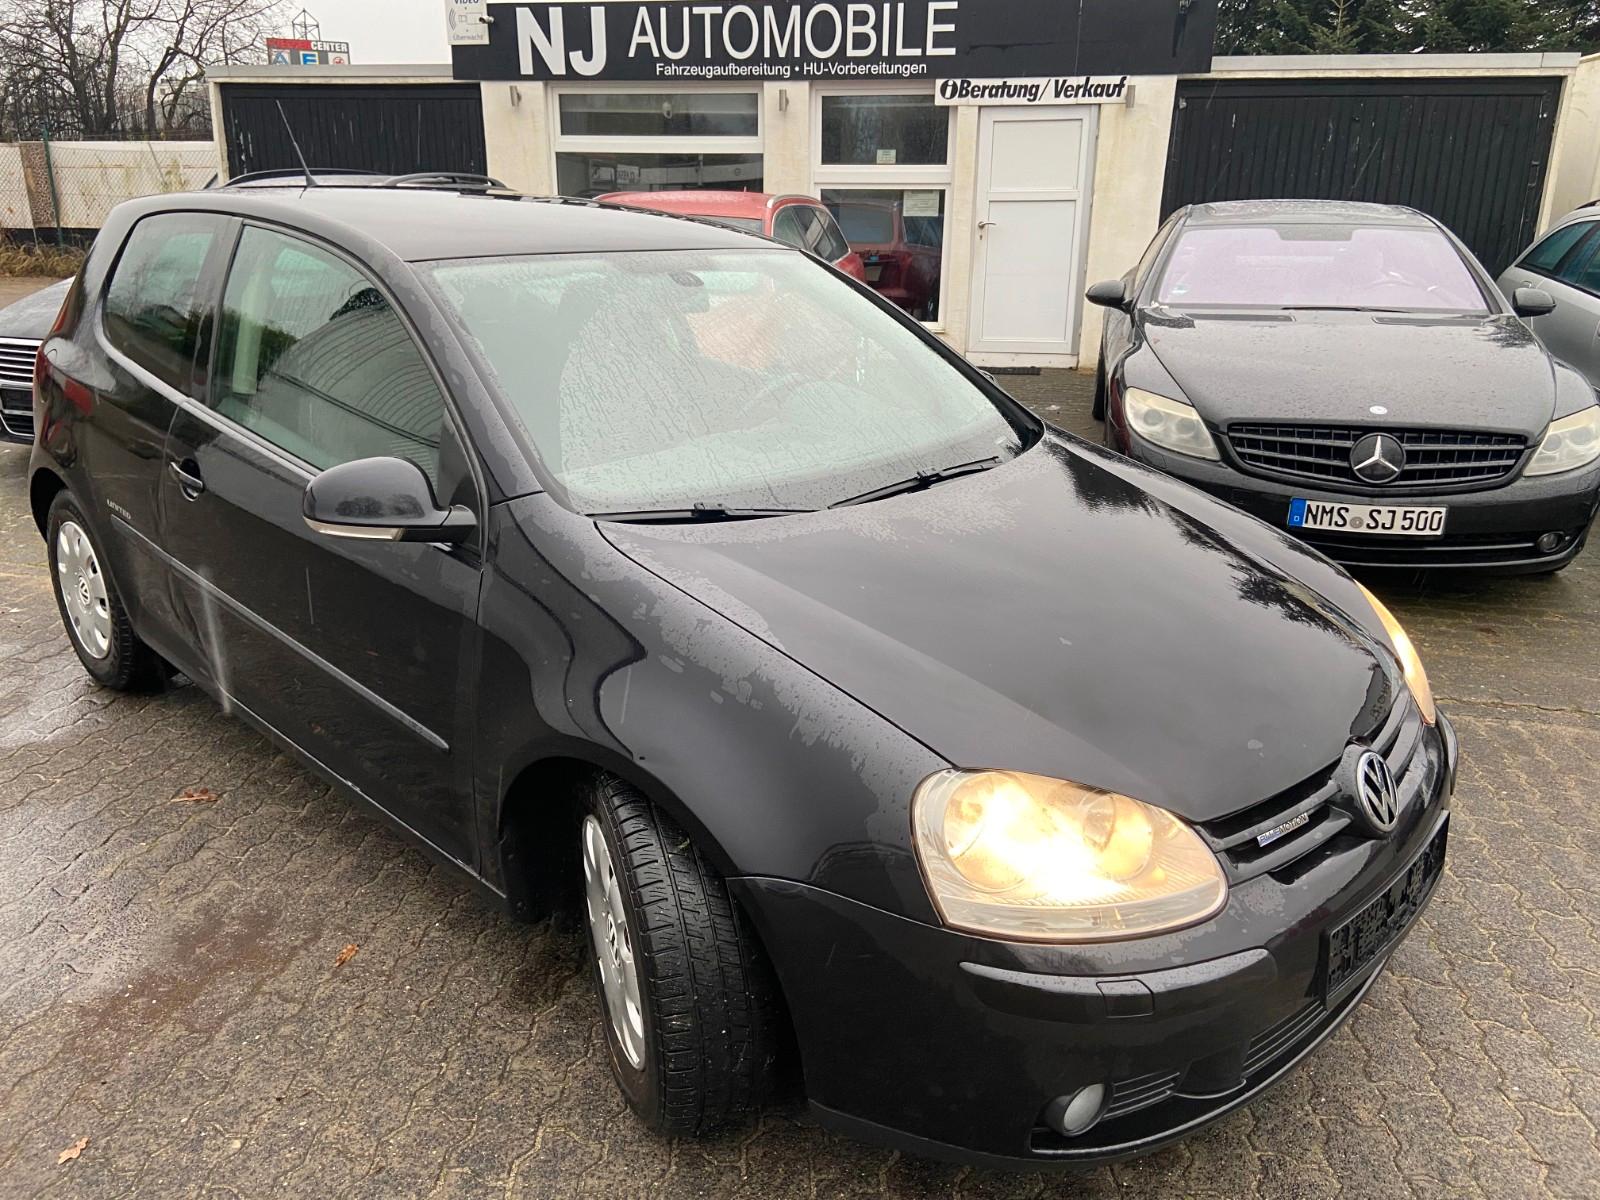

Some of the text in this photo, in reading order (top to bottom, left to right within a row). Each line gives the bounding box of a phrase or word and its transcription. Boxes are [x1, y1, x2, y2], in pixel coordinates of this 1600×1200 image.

[310, 41, 348, 52] CENTER
[516, 2, 959, 76] NJ AUTOMOBILE
[656, 61, 927, 79] Fahrzeugaufbereitung HU-Vorbereitungen
[1304, 503, 1350, 527] NMS
